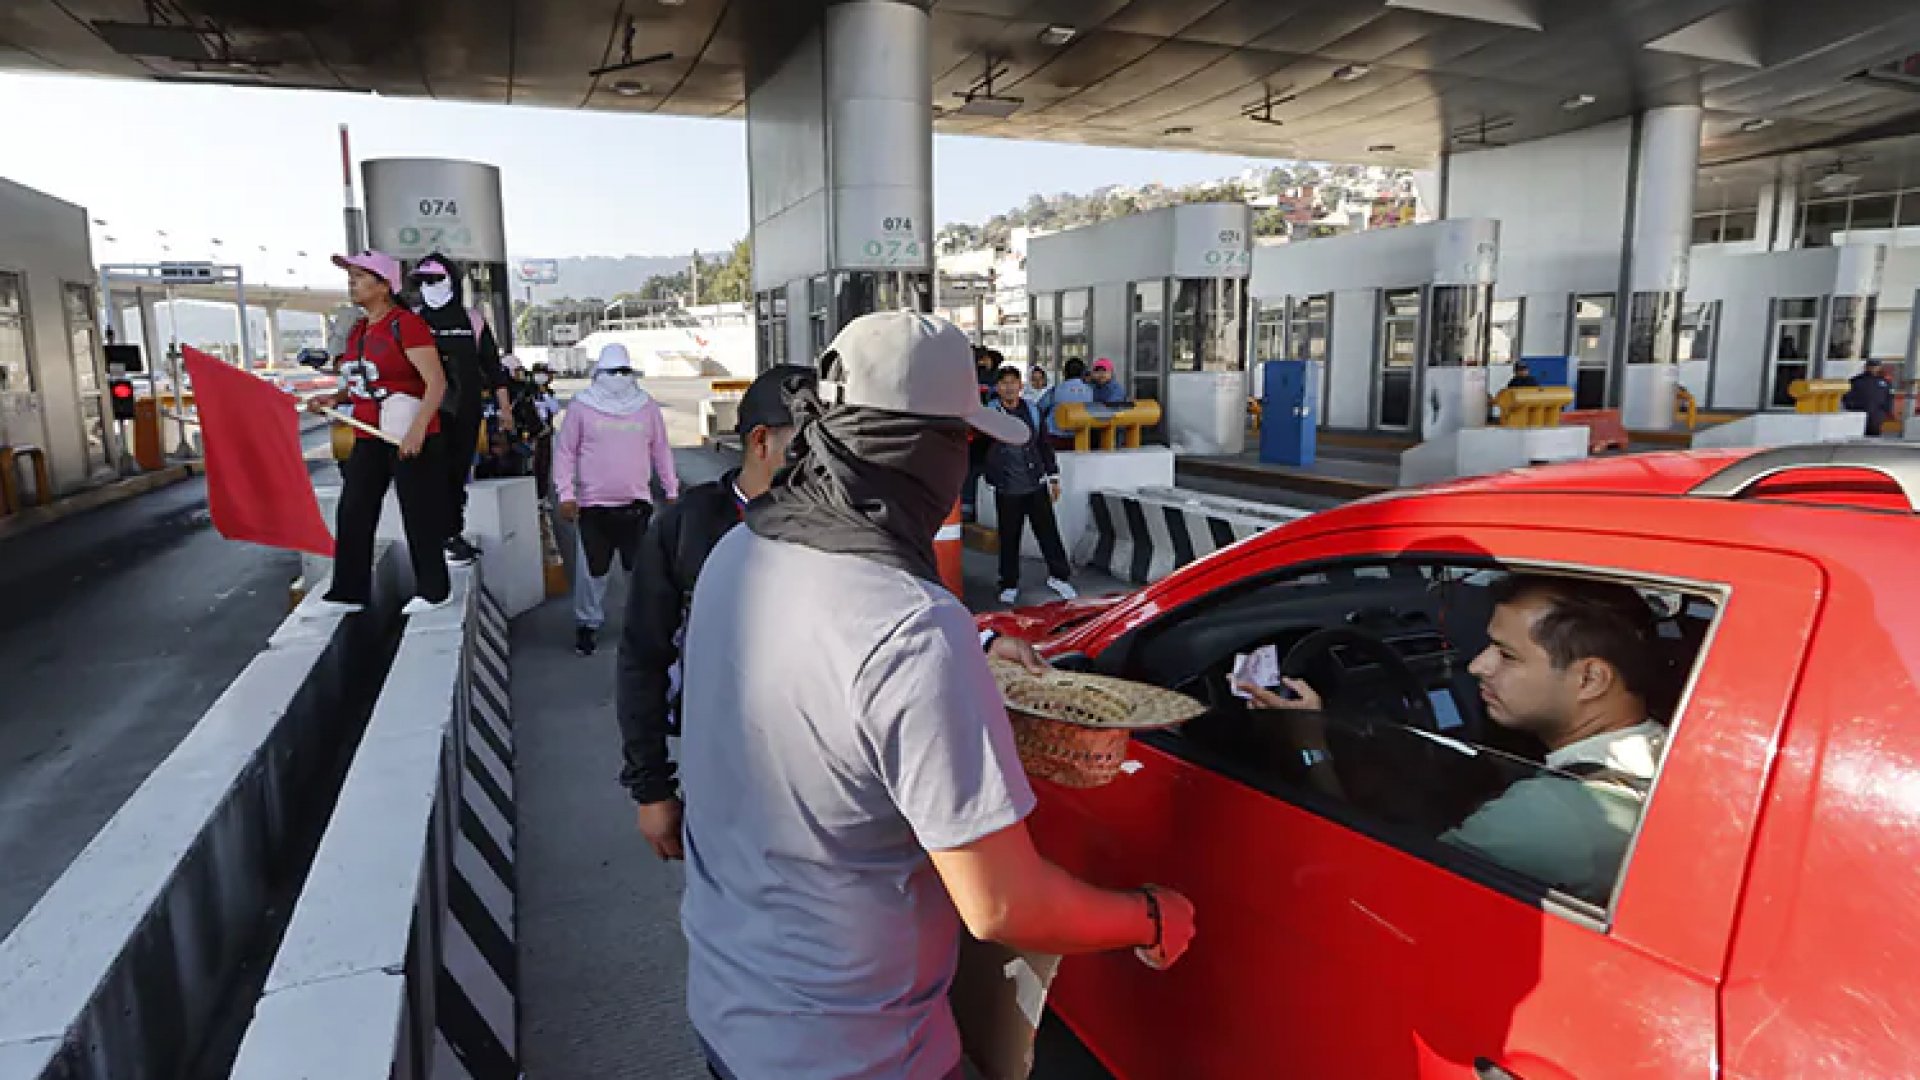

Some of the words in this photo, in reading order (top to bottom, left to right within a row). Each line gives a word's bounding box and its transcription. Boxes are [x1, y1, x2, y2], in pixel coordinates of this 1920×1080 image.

[419, 199, 457, 216] 074
[882, 217, 912, 231] 074
[399, 227, 472, 247] 074
[863, 239, 918, 257] 074
